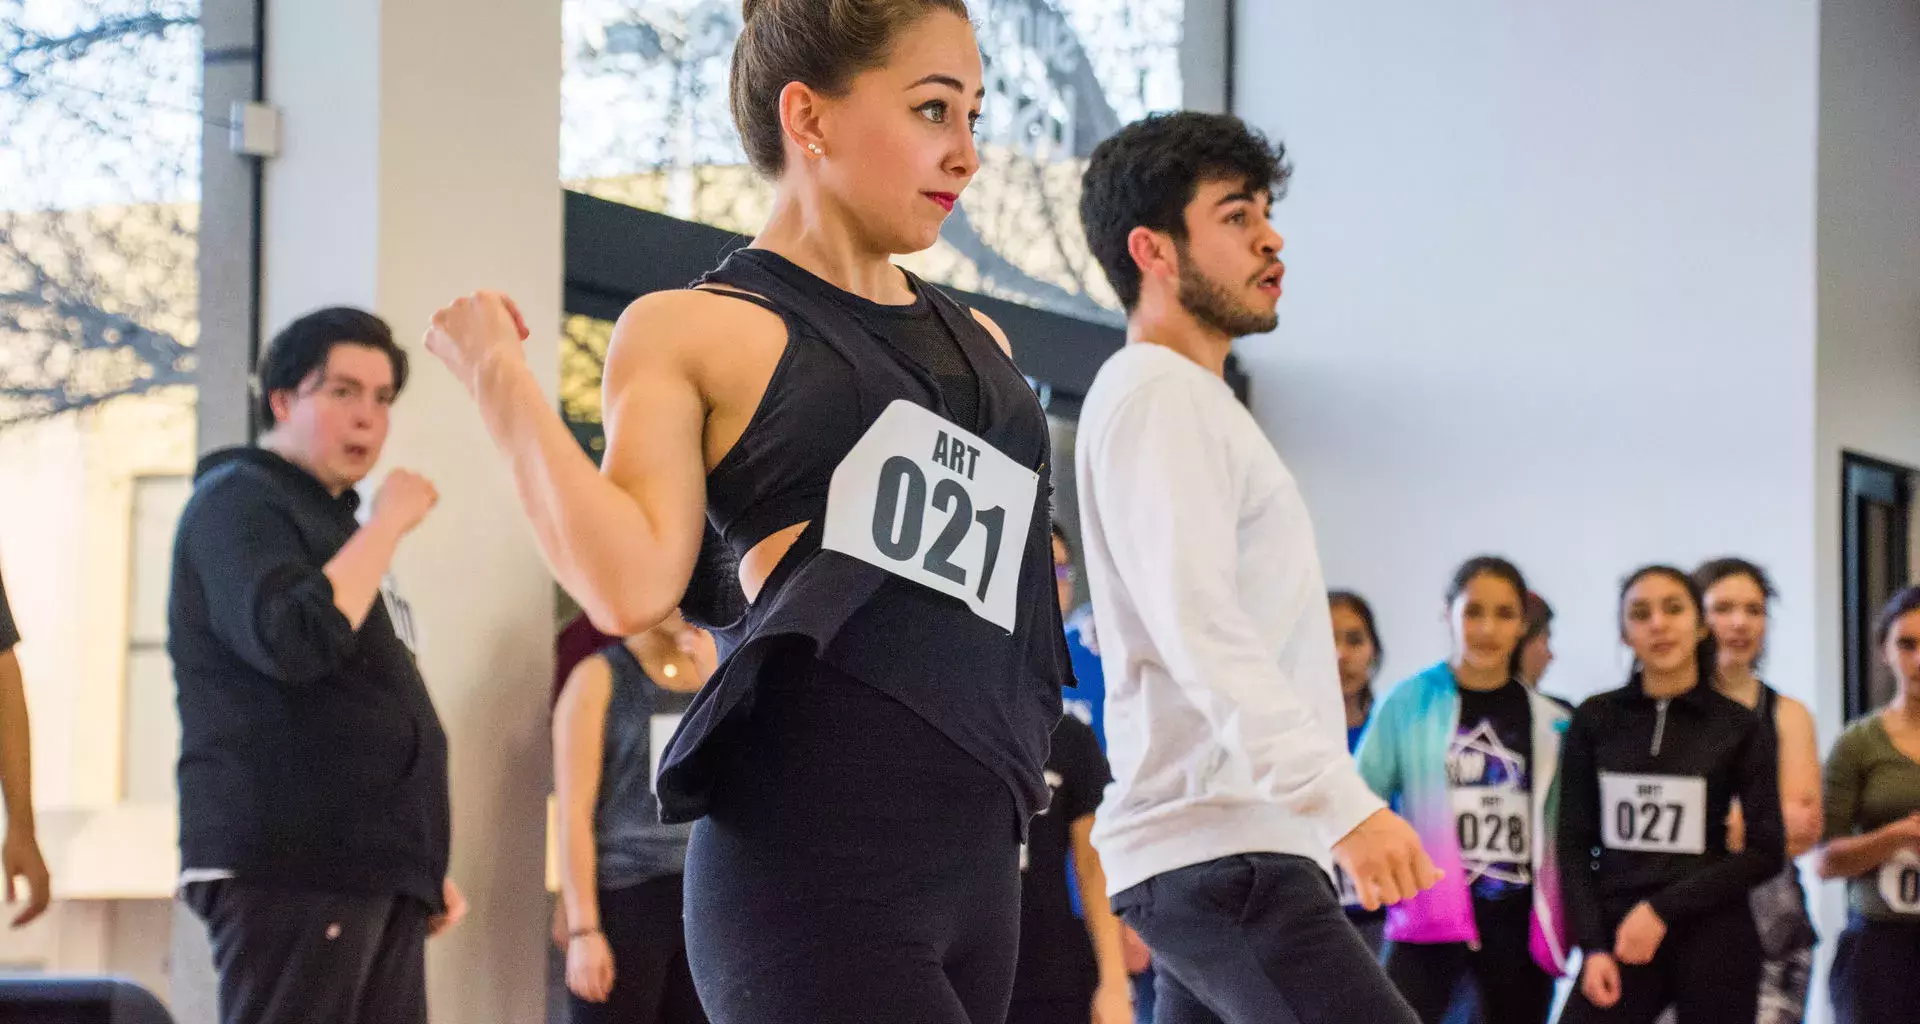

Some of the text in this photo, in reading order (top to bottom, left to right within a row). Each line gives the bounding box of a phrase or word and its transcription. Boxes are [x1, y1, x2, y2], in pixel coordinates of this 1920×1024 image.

[931, 430, 981, 481] ART
[872, 455, 1005, 604] 021
[1458, 812, 1524, 854] 028
[1617, 801, 1684, 843] 027
